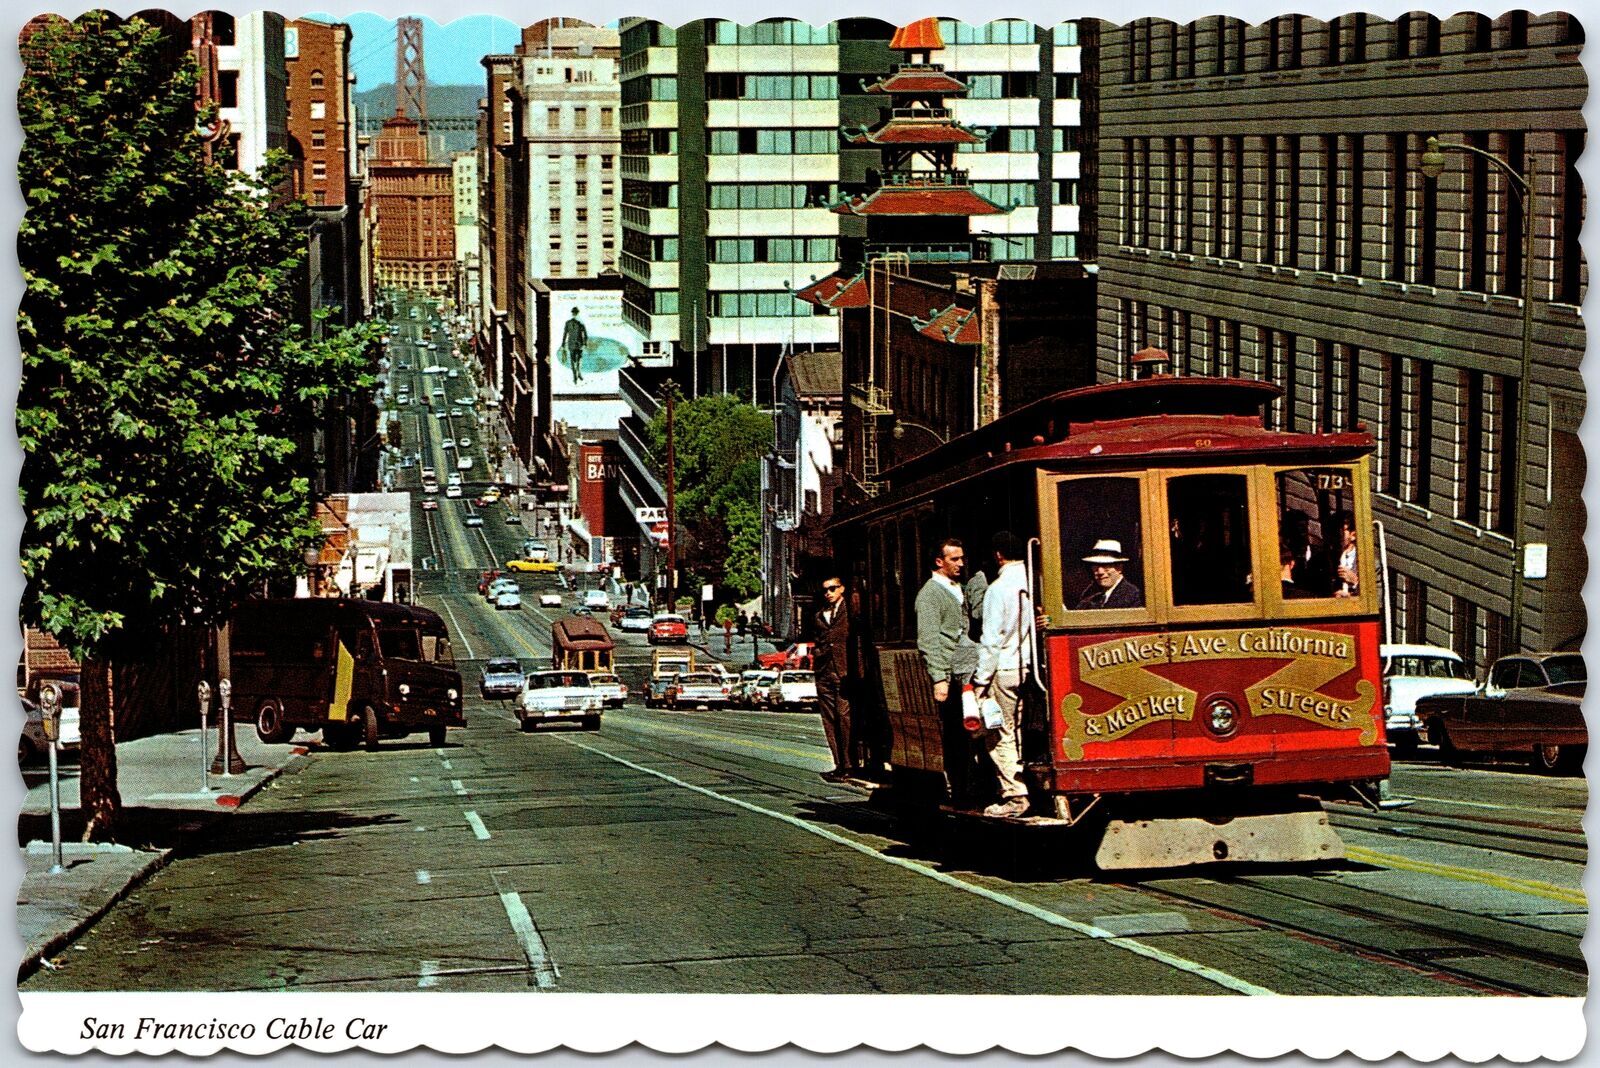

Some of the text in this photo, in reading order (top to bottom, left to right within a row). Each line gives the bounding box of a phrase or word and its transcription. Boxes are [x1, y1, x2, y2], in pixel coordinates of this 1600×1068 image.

[1083, 648, 1125, 671] Van
[1125, 639, 1177, 665] Ness
[1239, 631, 1348, 659] California
[1085, 687, 1353, 736] & Market Streets
